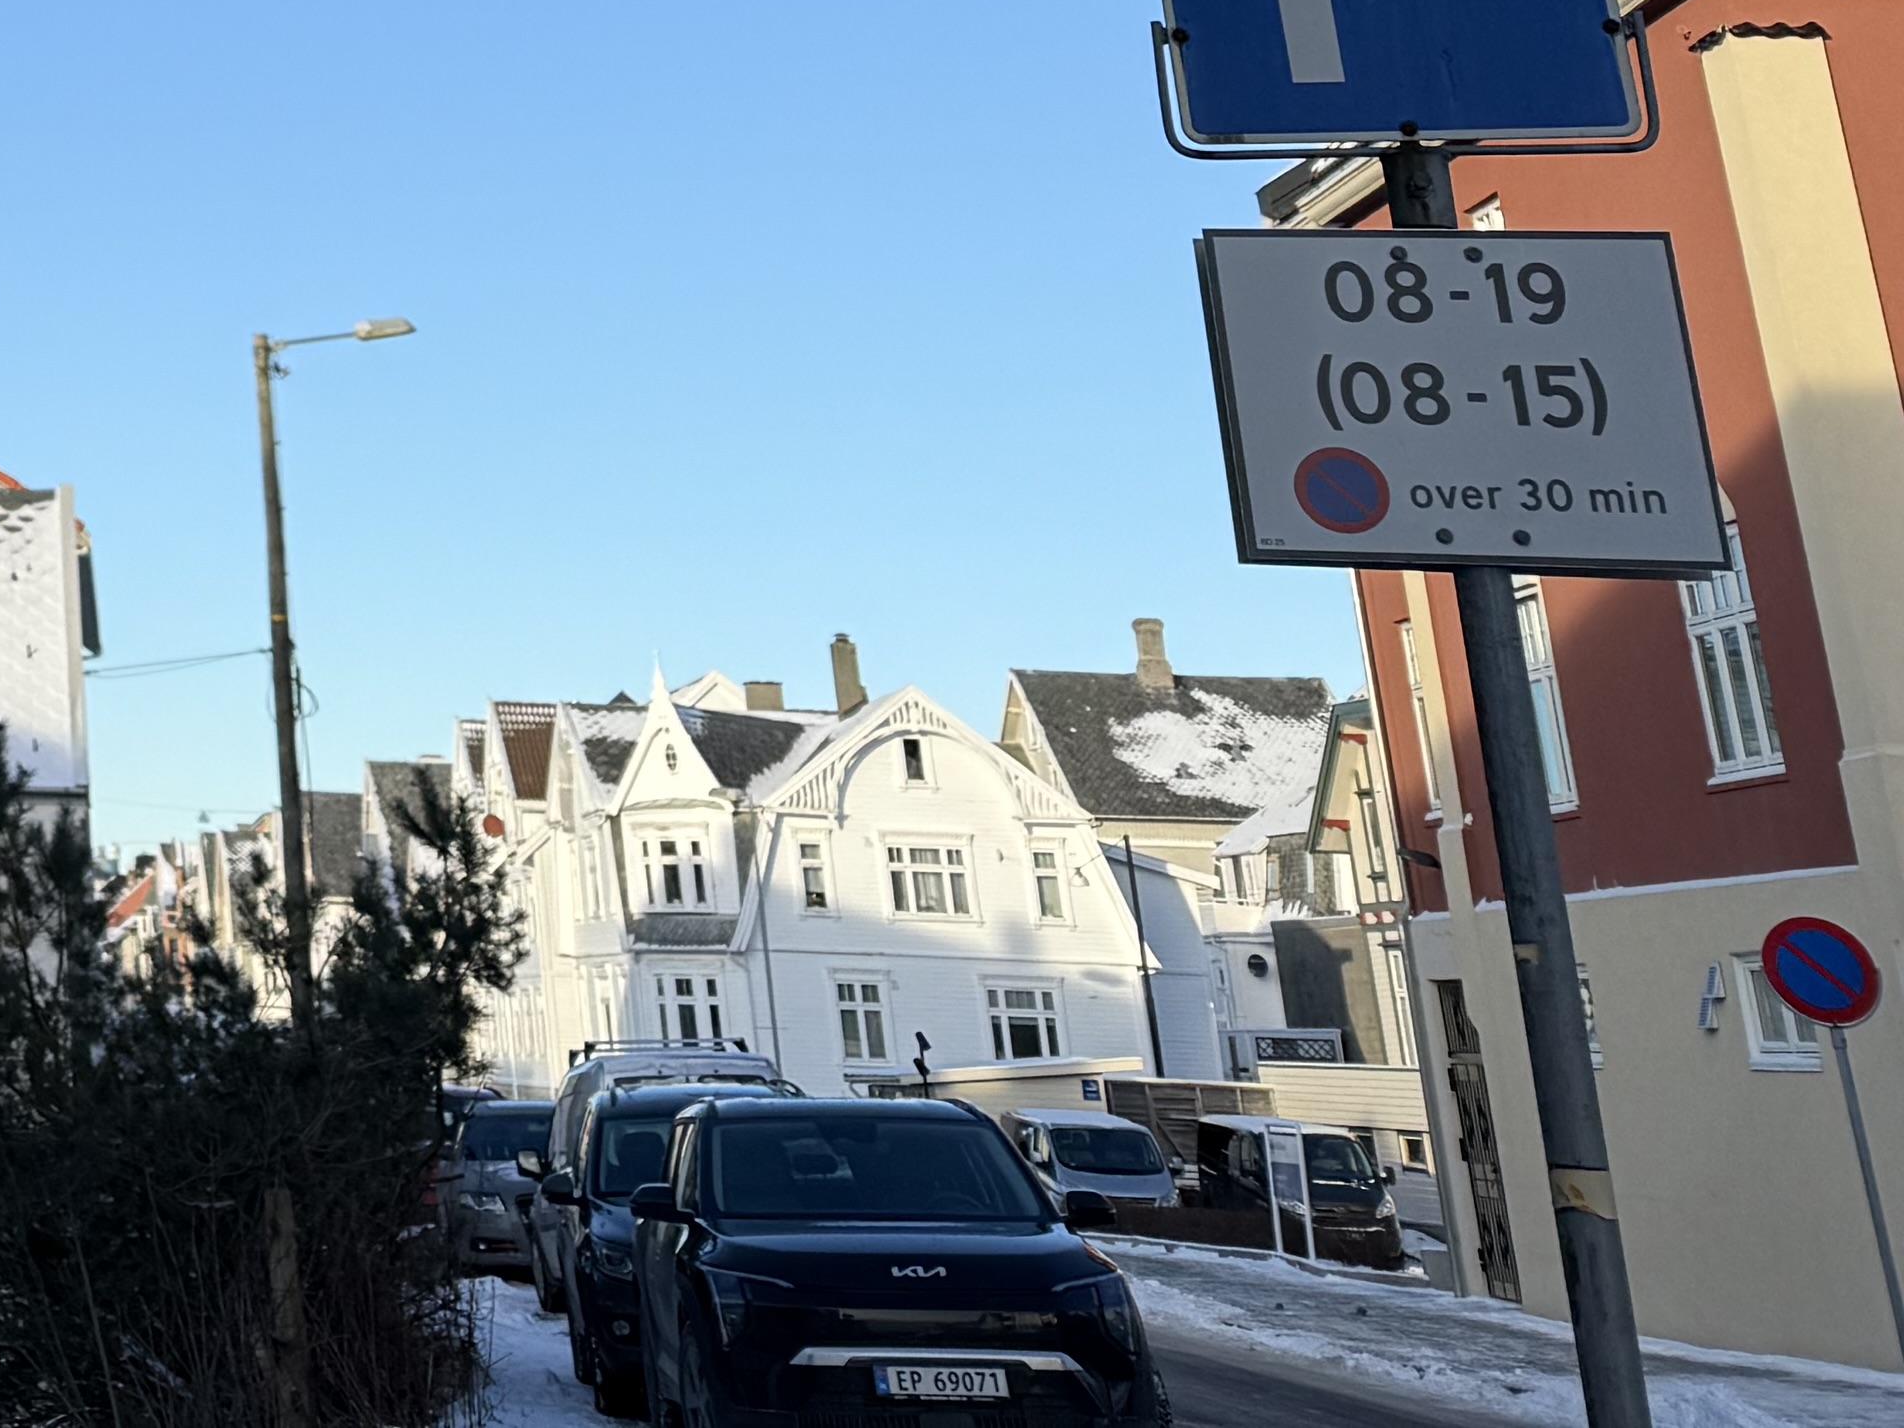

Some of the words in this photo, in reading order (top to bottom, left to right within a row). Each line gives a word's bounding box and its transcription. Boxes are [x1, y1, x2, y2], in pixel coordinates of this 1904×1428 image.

[1409, 484, 1502, 510] over
[1517, 477, 1574, 512] 30
[1588, 480, 1667, 514] min
[896, 1370, 922, 1392] EP
[934, 1370, 1000, 1394] 69071
